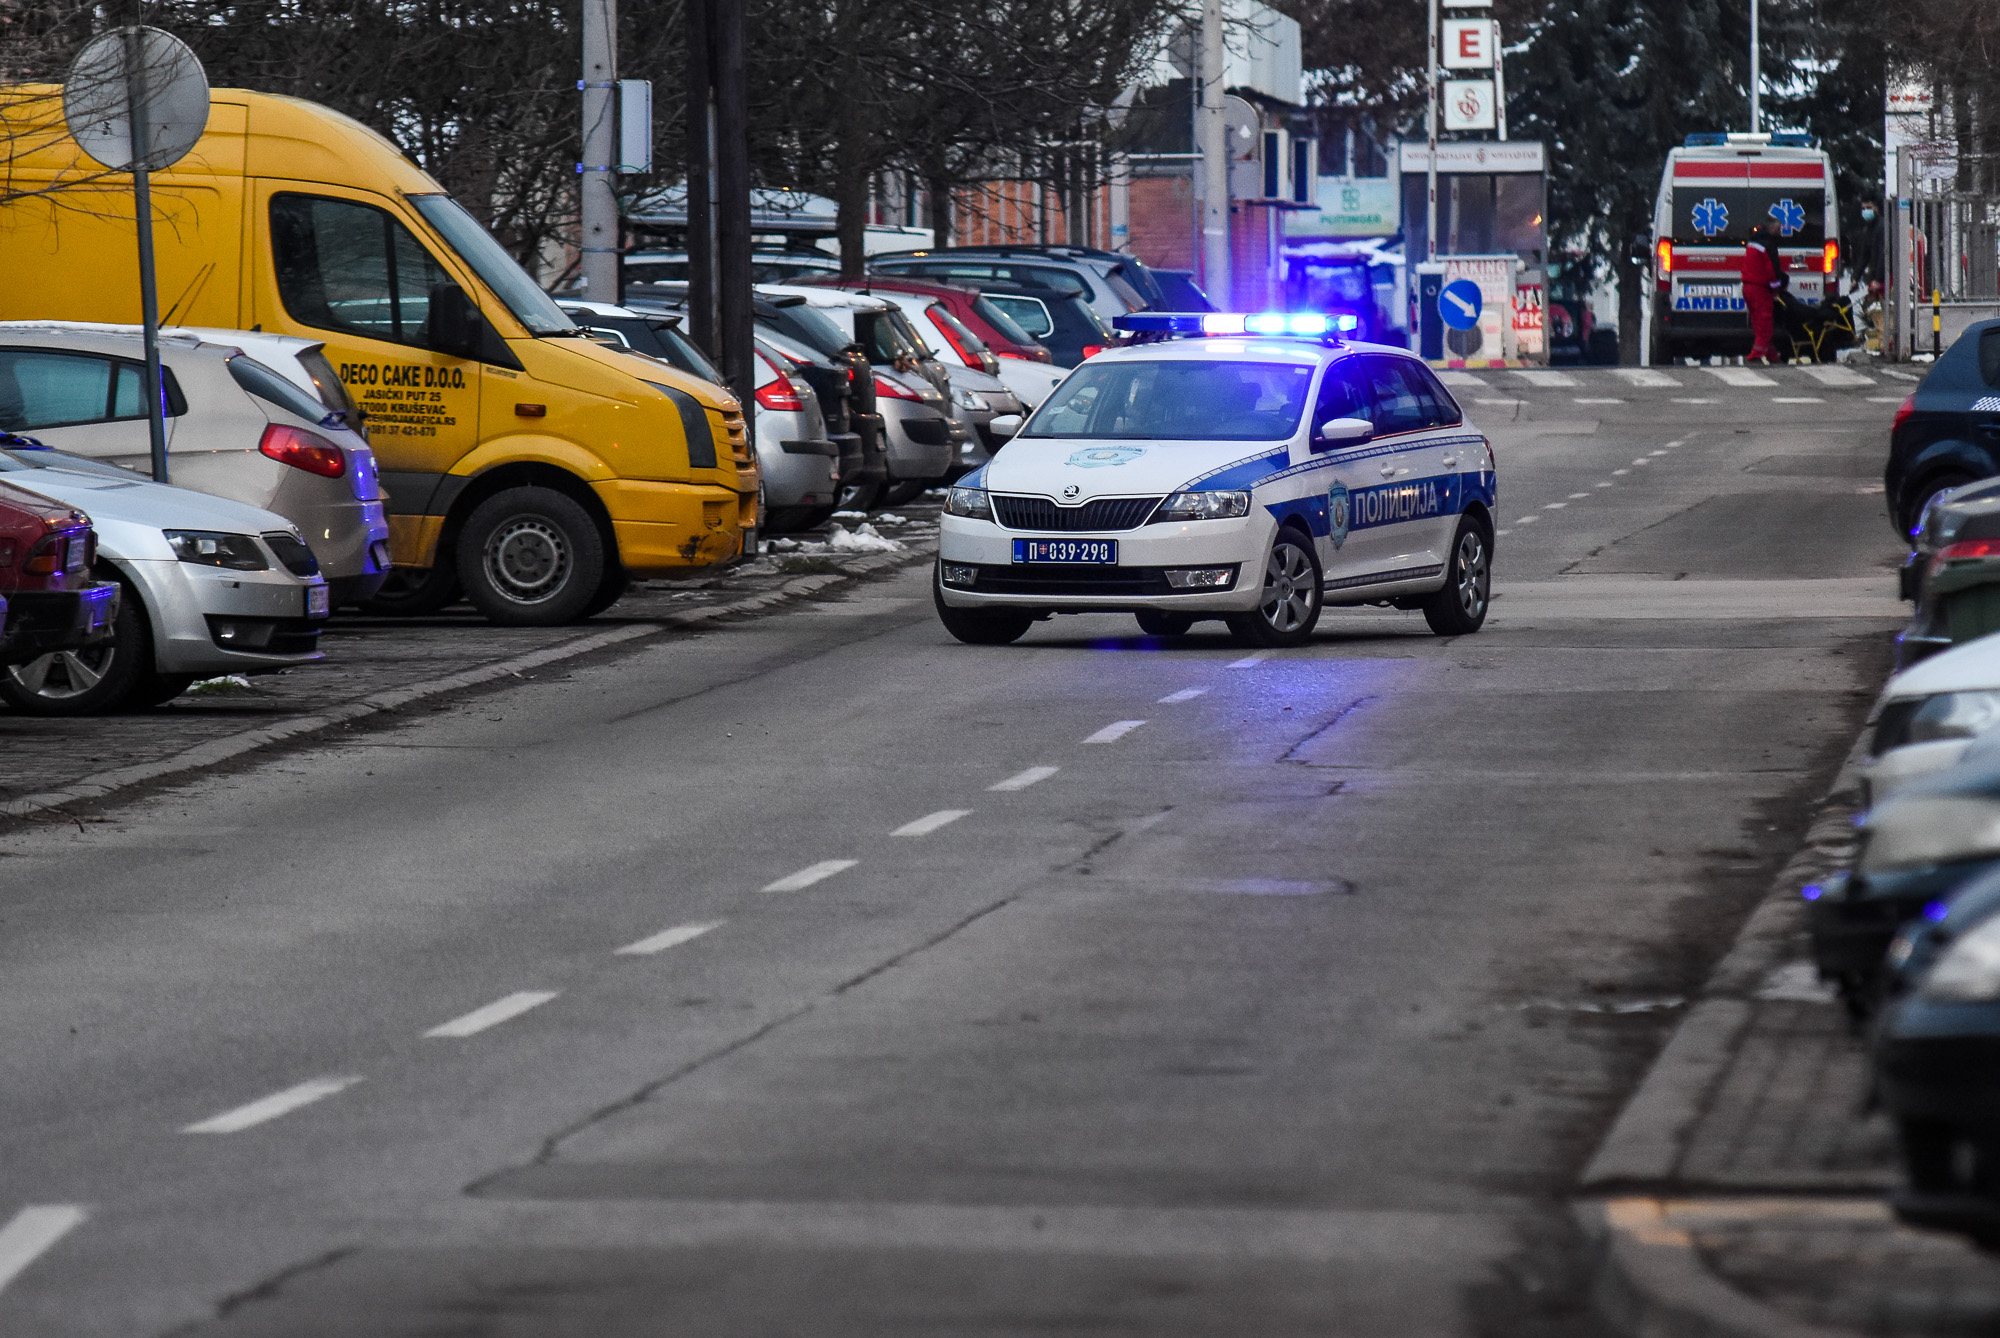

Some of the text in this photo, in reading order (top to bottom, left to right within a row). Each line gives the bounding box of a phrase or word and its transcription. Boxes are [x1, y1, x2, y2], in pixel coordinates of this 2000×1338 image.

[1459, 29, 1480, 57] E
[1447, 260, 1507, 275] ARKING
[340, 363, 378, 385] DECO
[382, 365, 420, 387] CAKE
[425, 367, 466, 389] D.O.O.
[363, 388, 442, 402] JASIČKI PUT 25
[358, 402, 446, 415] 37000 KRUŠEVAC
[1355, 481, 1438, 525] ПОЛИЦИЈА
